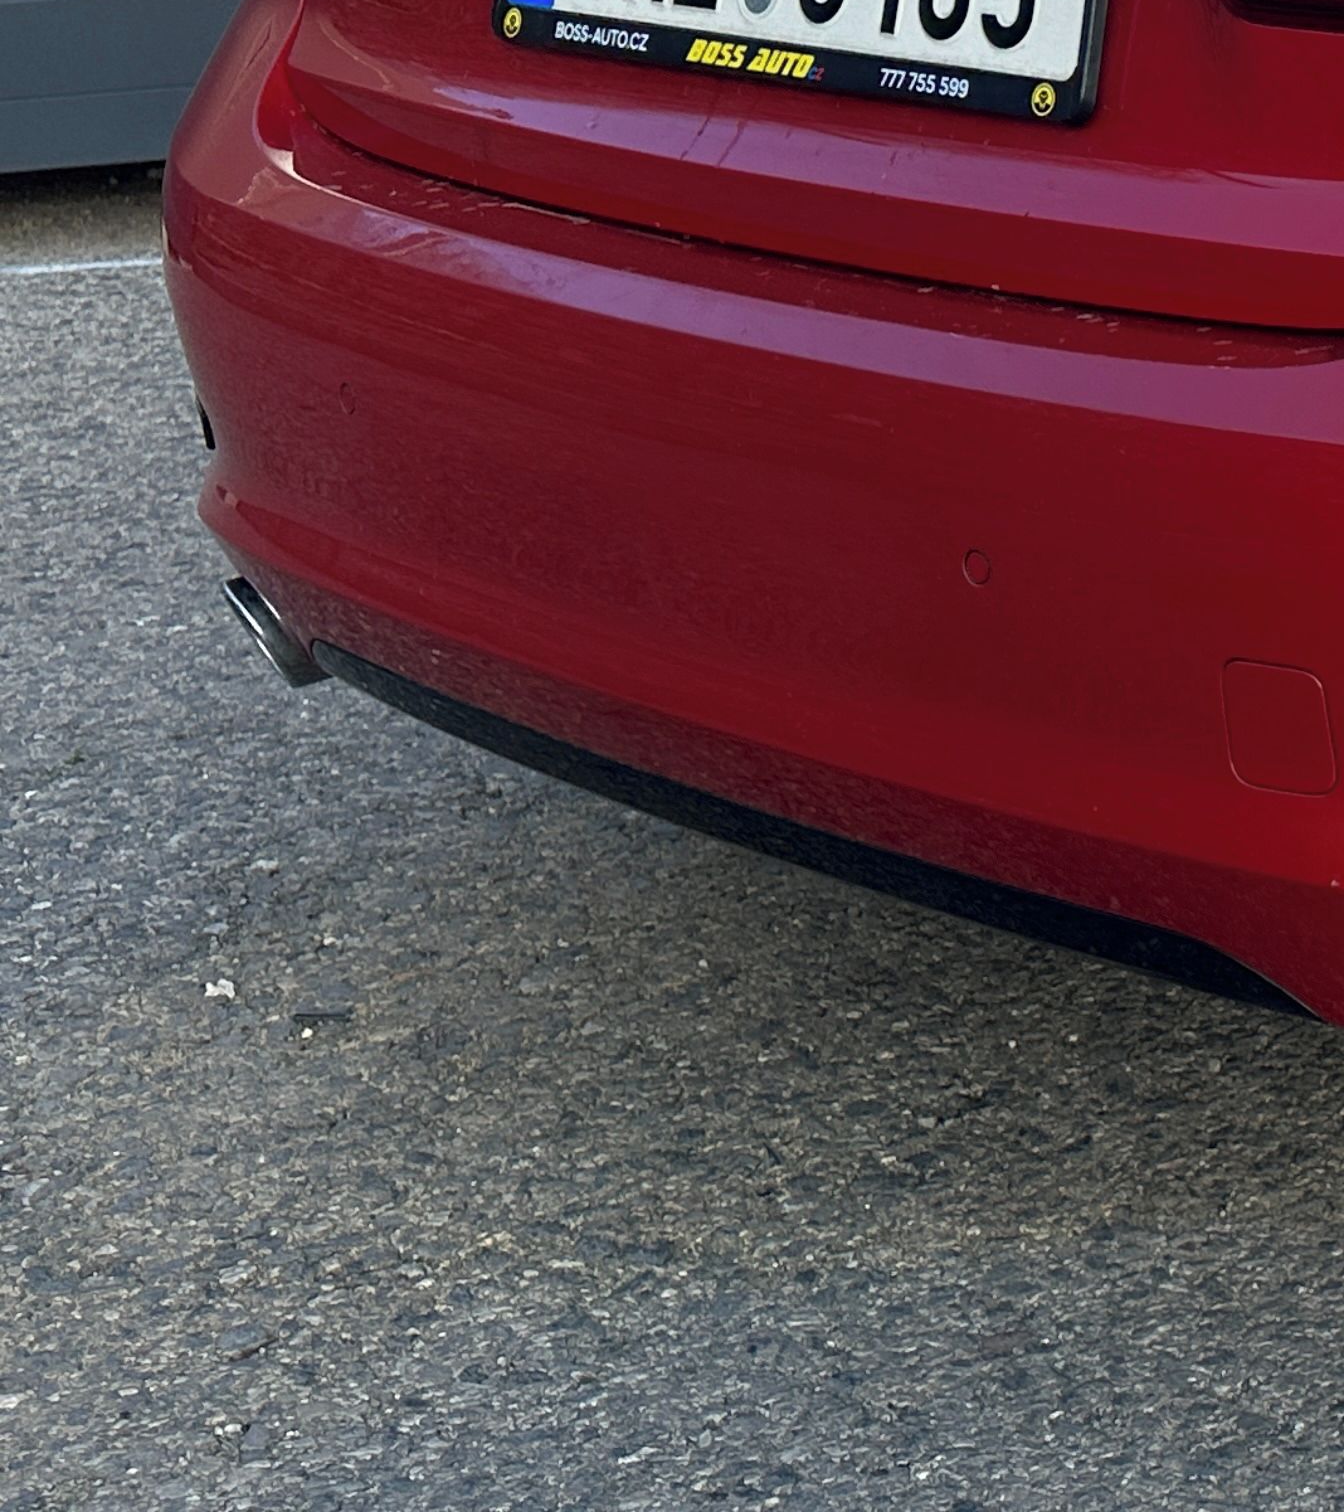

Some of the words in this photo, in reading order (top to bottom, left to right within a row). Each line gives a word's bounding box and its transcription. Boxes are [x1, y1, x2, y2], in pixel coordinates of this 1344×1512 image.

[554, 20, 650, 53] BOSS-AUTO.CZ
[685, 38, 749, 70] BOSS
[746, 47, 816, 79] AUTO
[879, 67, 906, 89] 777
[908, 72, 936, 94] 755
[938, 75, 970, 99] 599
